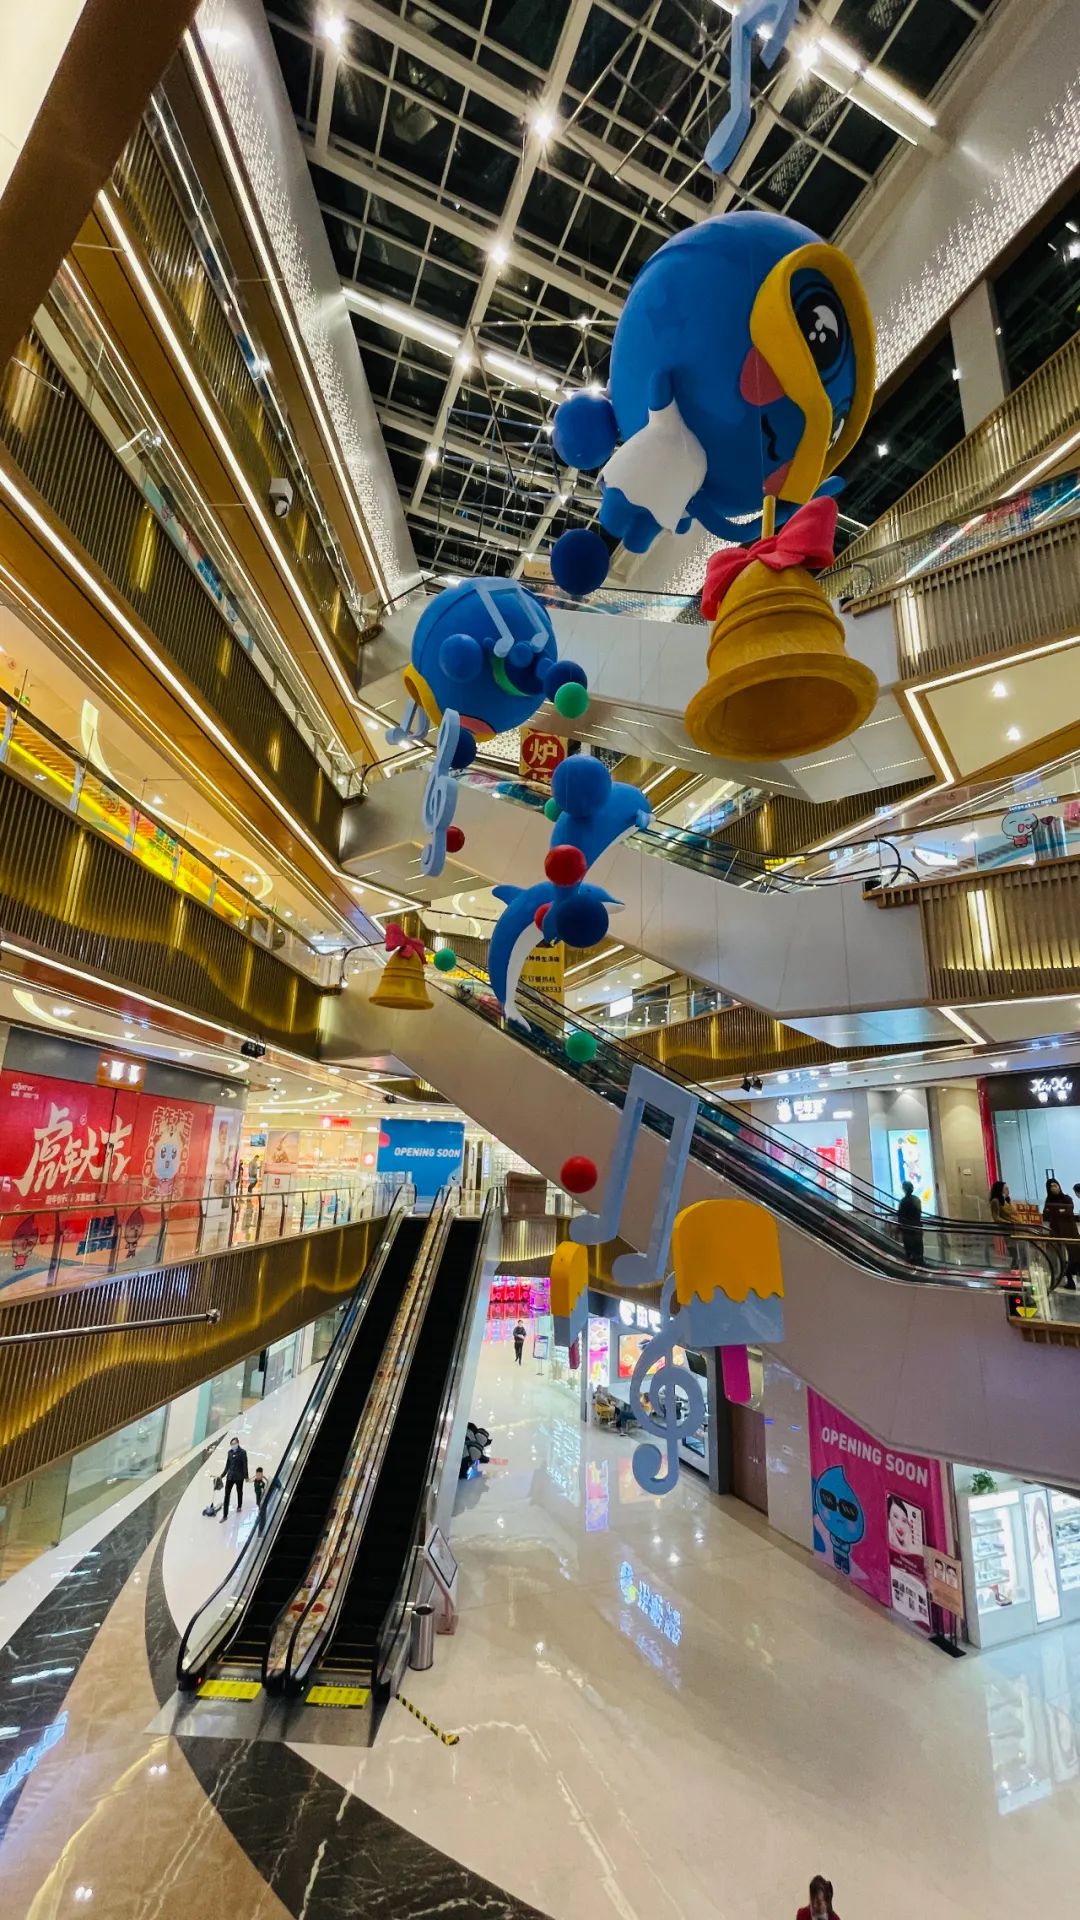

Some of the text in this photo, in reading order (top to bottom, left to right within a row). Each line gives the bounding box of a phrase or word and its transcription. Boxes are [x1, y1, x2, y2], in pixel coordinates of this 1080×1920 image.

[529, 738, 558, 766] 炉
[394, 1147, 461, 1158] OPENING SOON
[821, 1426, 928, 1488] OPENING SOON
